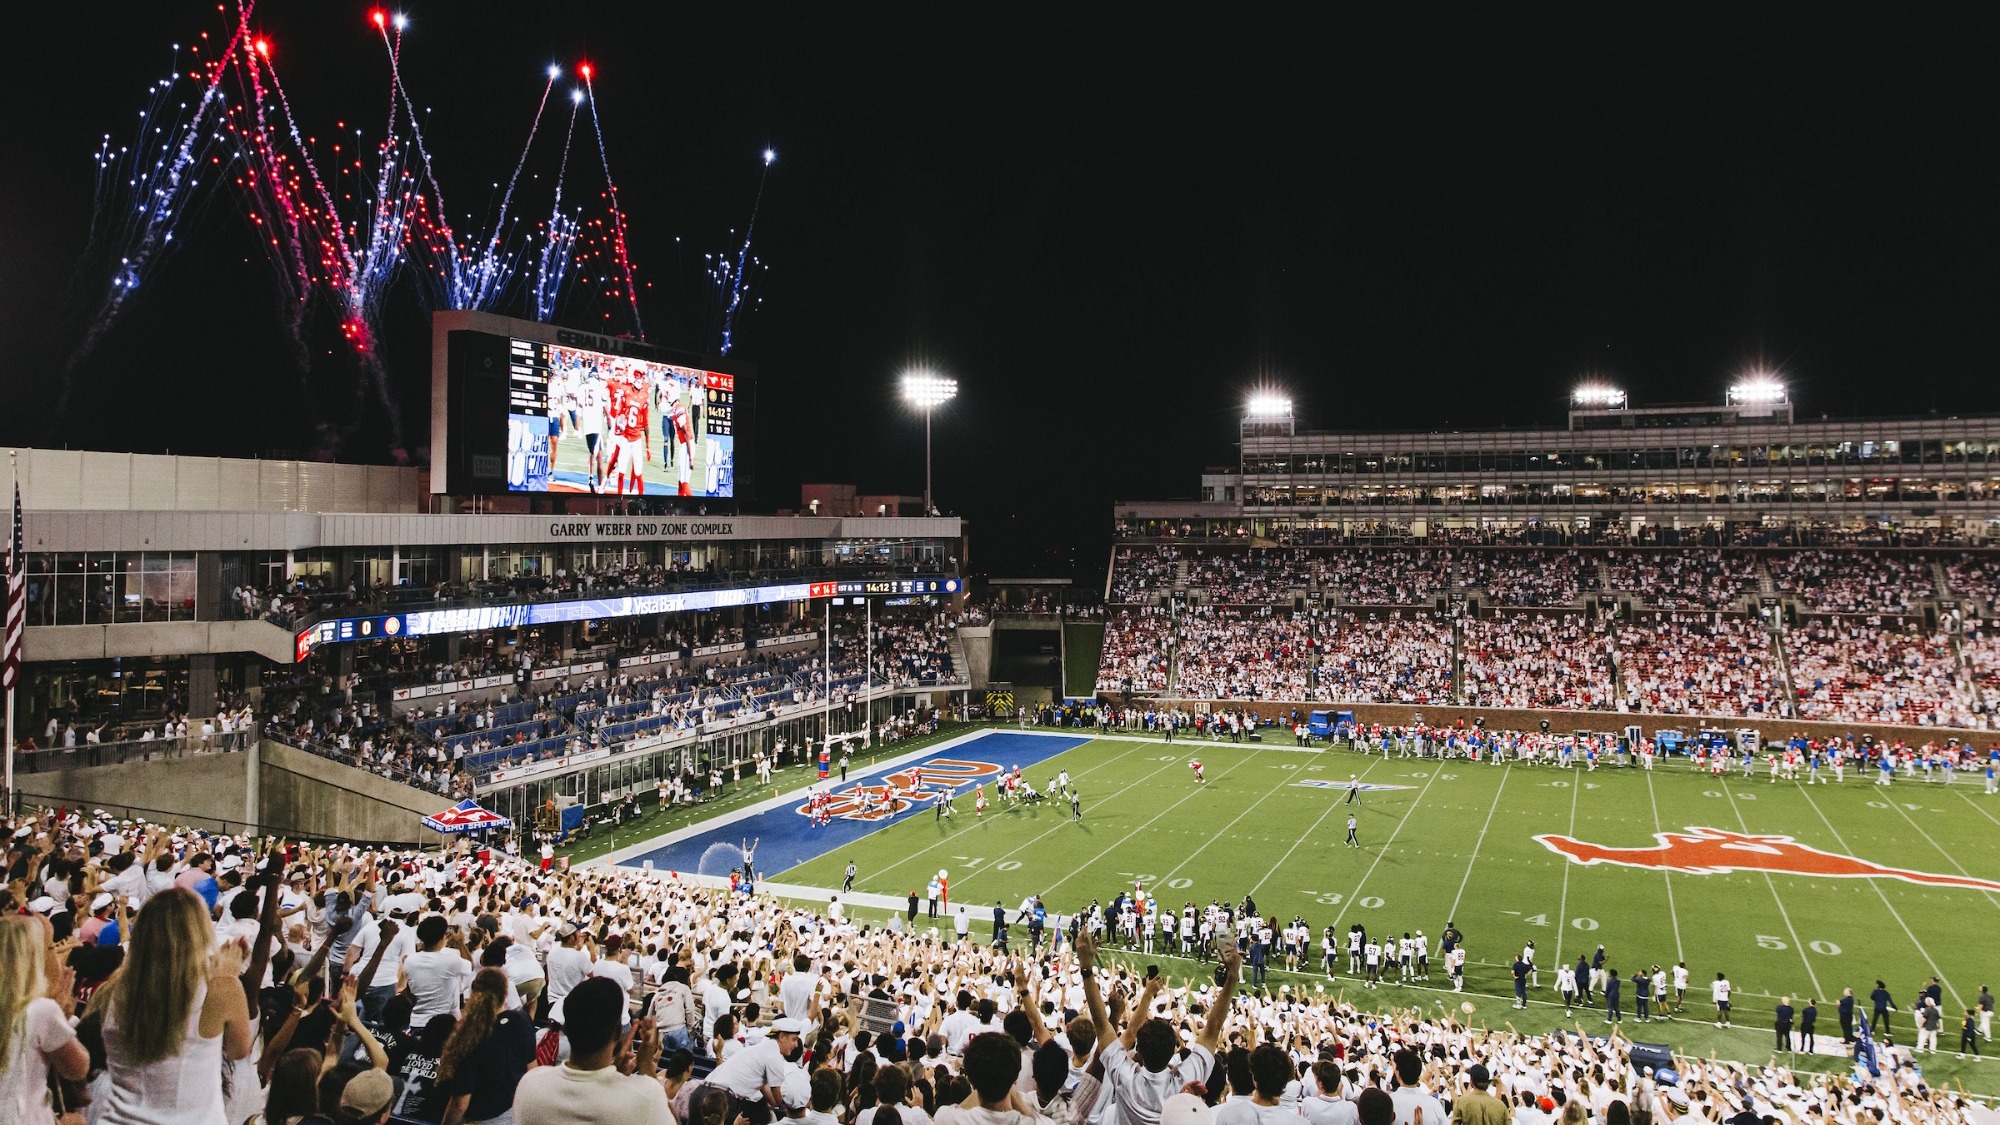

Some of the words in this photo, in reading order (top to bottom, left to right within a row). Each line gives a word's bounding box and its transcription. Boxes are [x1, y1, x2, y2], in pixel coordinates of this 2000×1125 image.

[720, 377, 728, 387] 14
[708, 406, 726, 418] 14:12
[628, 407, 638, 428] 6
[723, 426, 731, 435] 22
[550, 523, 591, 536] GARRY
[596, 523, 632, 536] WEBER
[637, 523, 658, 535] END
[661, 523, 688, 535] ZONE
[691, 523, 733, 535] COMPLEX
[838, 584, 847, 592] 1ST
[866, 583, 890, 592] 14:12
[930, 581, 937, 591] 0
[634, 597, 659, 614] Vista
[660, 595, 686, 612] Bank
[362, 620, 372, 636] 0
[487, 677, 501, 685] SMU
[427, 686, 442, 694] SMU
[584, 753, 596, 761] SMU
[524, 766, 538, 774] SMU
[795, 758, 1004, 821] SMU
[445, 824, 465, 832] SMU
[468, 822, 488, 830] SMU
[490, 820, 510, 828] SMU
[1368, 947, 1377, 956] 57
[1404, 942, 1412, 951] 34
[408, 1060, 433, 1070] LOVED
[410, 1066, 438, 1079] WORLD
